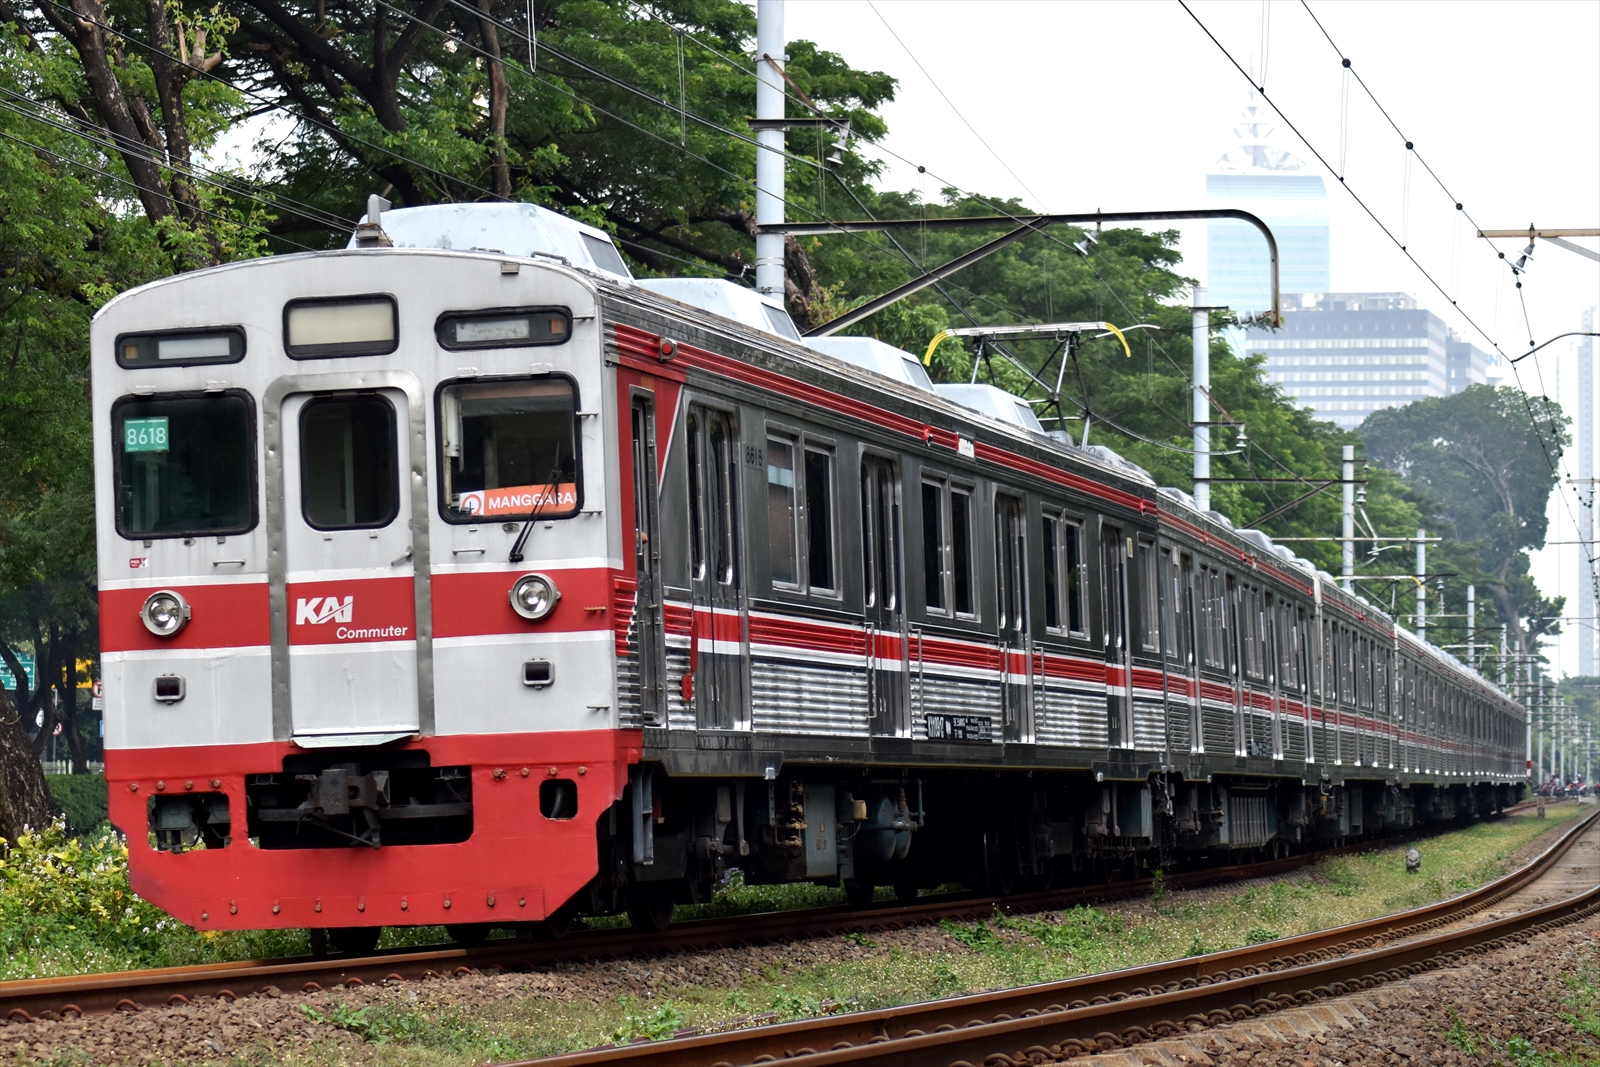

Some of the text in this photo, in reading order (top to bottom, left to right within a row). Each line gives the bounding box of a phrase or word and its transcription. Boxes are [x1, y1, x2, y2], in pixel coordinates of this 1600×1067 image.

[127, 427, 166, 445] 8618
[746, 446, 763, 466] 8618
[295, 595, 354, 625] KAI
[336, 626, 408, 639] Commuter
